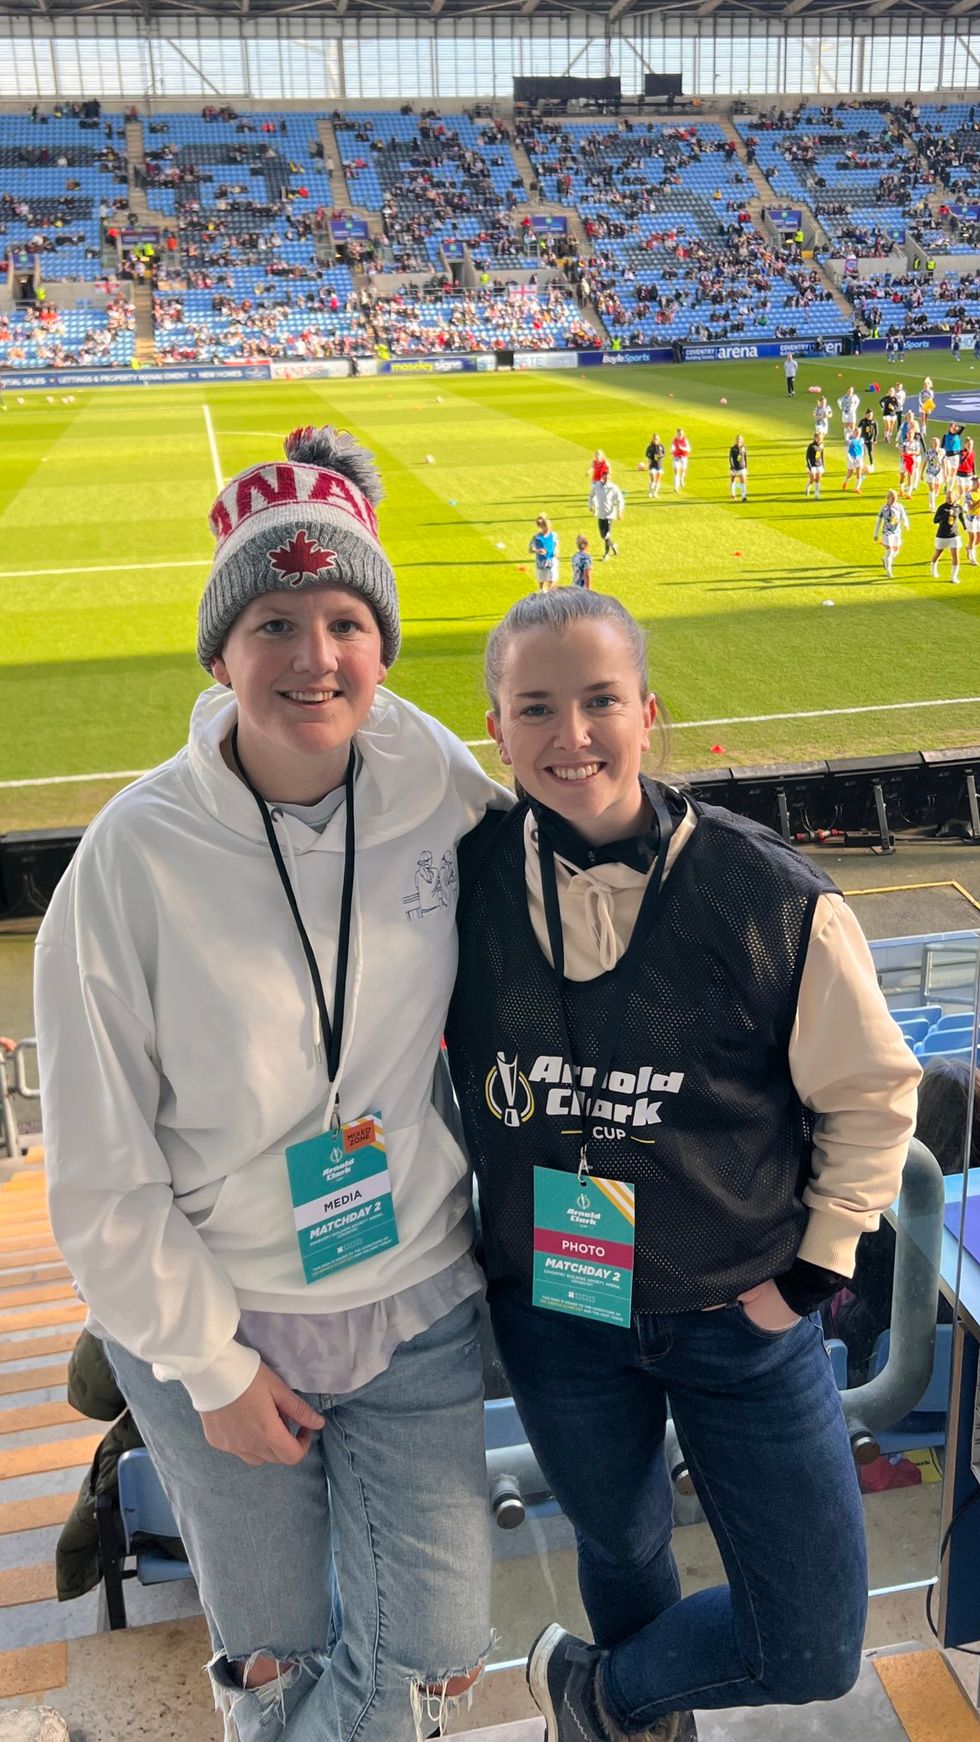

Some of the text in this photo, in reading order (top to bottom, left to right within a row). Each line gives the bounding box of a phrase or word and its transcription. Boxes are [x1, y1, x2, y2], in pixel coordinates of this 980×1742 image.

[602, 352, 650, 365] BoyleSports
[718, 346, 759, 359] arena
[347, 1127, 371, 1141] MIXED
[592, 1126, 627, 1140] CUP
[349, 1135, 371, 1146] ZONE
[322, 1158, 355, 1177] Arnold
[326, 1167, 352, 1182] Clark
[323, 1190, 362, 1213] MEDIA
[309, 1201, 382, 1240] MATCHDAY 2
[566, 1208, 601, 1219] Arnold
[570, 1215, 597, 1225] Clark
[562, 1240, 605, 1257] PHOTO
[545, 1258, 621, 1281] MATCHDAY 2
